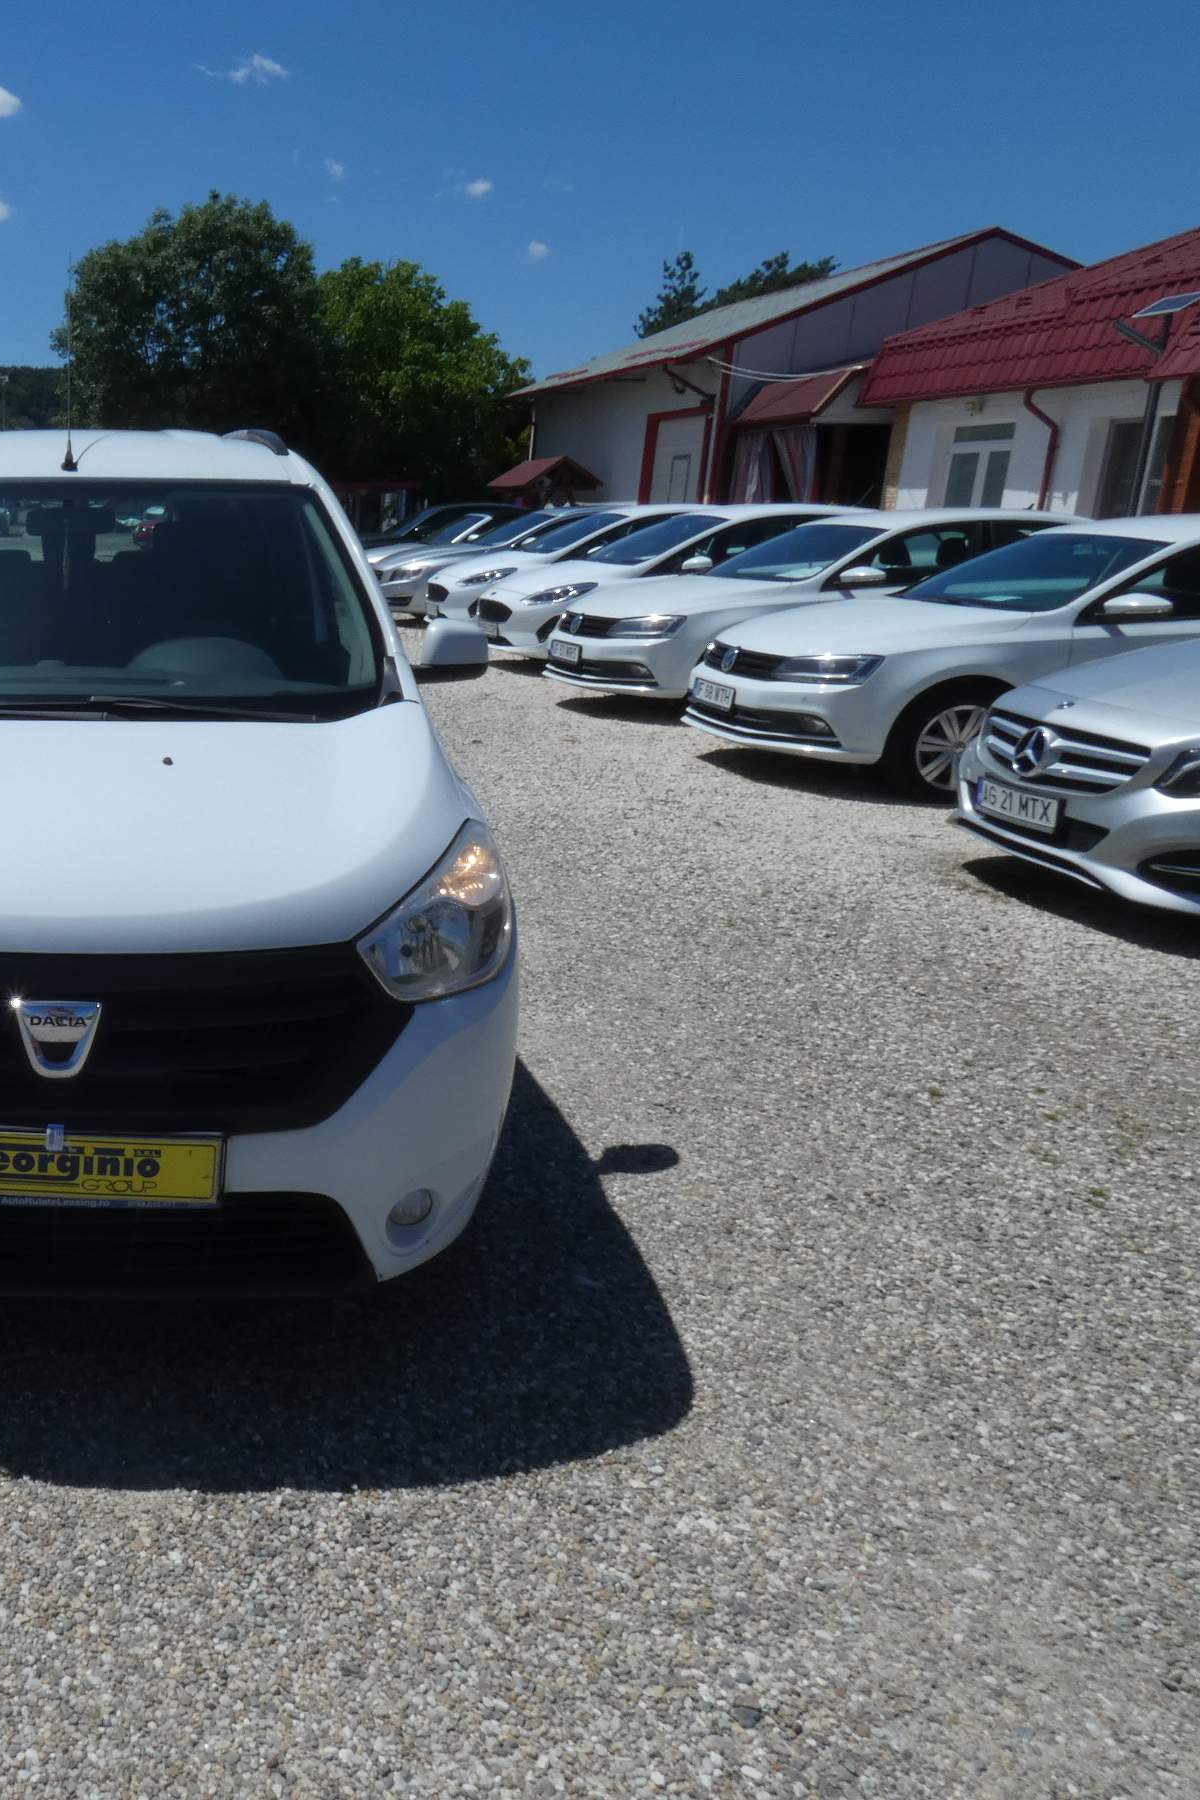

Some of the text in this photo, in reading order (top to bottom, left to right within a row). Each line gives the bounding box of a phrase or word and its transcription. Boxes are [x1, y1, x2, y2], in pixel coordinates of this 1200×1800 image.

[982, 783, 1052, 823] AG 21 MTX
[30, 1016, 88, 1027] DACIA
[81, 1178, 158, 1193] GROUP
